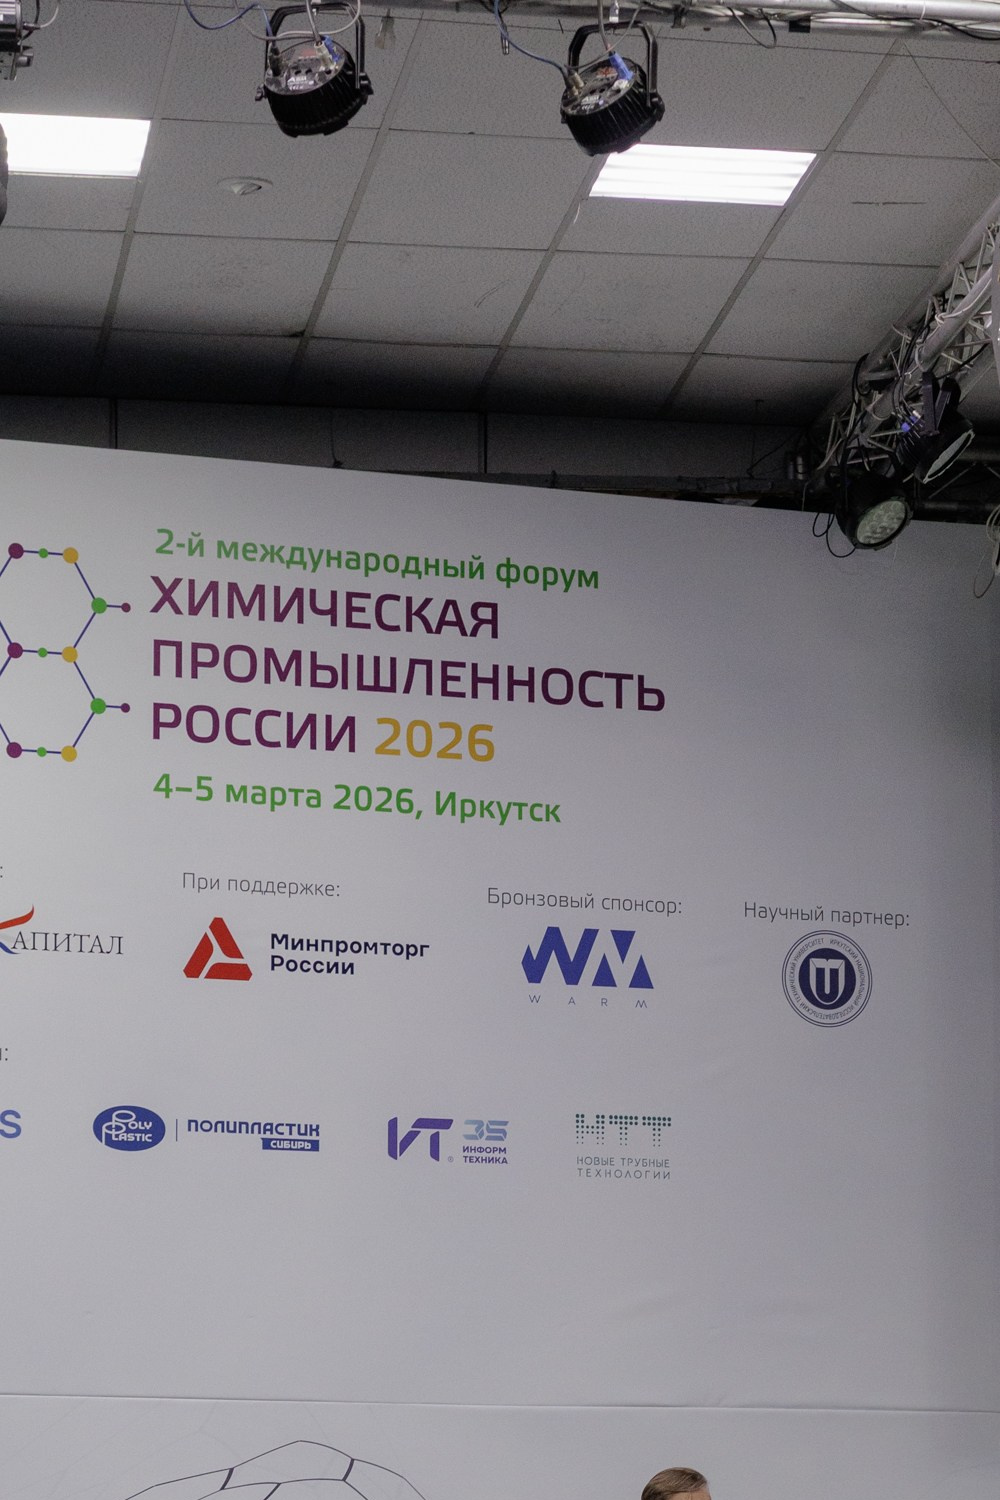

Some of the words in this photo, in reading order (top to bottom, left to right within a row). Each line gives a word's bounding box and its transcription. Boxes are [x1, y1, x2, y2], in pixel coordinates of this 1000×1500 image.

[156, 528, 205, 557] 2-й
[217, 541, 484, 580] международный
[496, 557, 598, 593] форум
[149, 575, 500, 640] ХИМИЧЕСКАЯ
[152, 639, 666, 712] ПРОМЫШЛЕННОСТЬ
[153, 703, 355, 752] РОССИИ
[375, 718, 494, 762] 2026
[226, 784, 321, 812] марта
[333, 784, 422, 819] 2026,
[436, 791, 561, 826] Иркутск
[183, 873, 219, 893] При
[228, 879, 339, 898] поддержке:
[488, 888, 594, 908] Бронзовый
[602, 898, 681, 917] спонсор:
[745, 902, 823, 923] Научный
[831, 911, 909, 929] партнер:
[271, 934, 429, 960] Минпромторг
[271, 955, 354, 975] России
[529, 994, 648, 1009] WARM
[187, 1118, 320, 1137] ПОЛИПЛАСТИК
[270, 1140, 312, 1150] СИБИРЬ
[462, 1145, 507, 1155] ИНФОРМ
[463, 1156, 508, 1164] ТЕХНИКА
[576, 1156, 615, 1166] НОВЫЕ
[620, 1157, 670, 1168] ТРУБНЫЕ
[577, 1168, 671, 1179] ТЕХНОЛОГИИ
